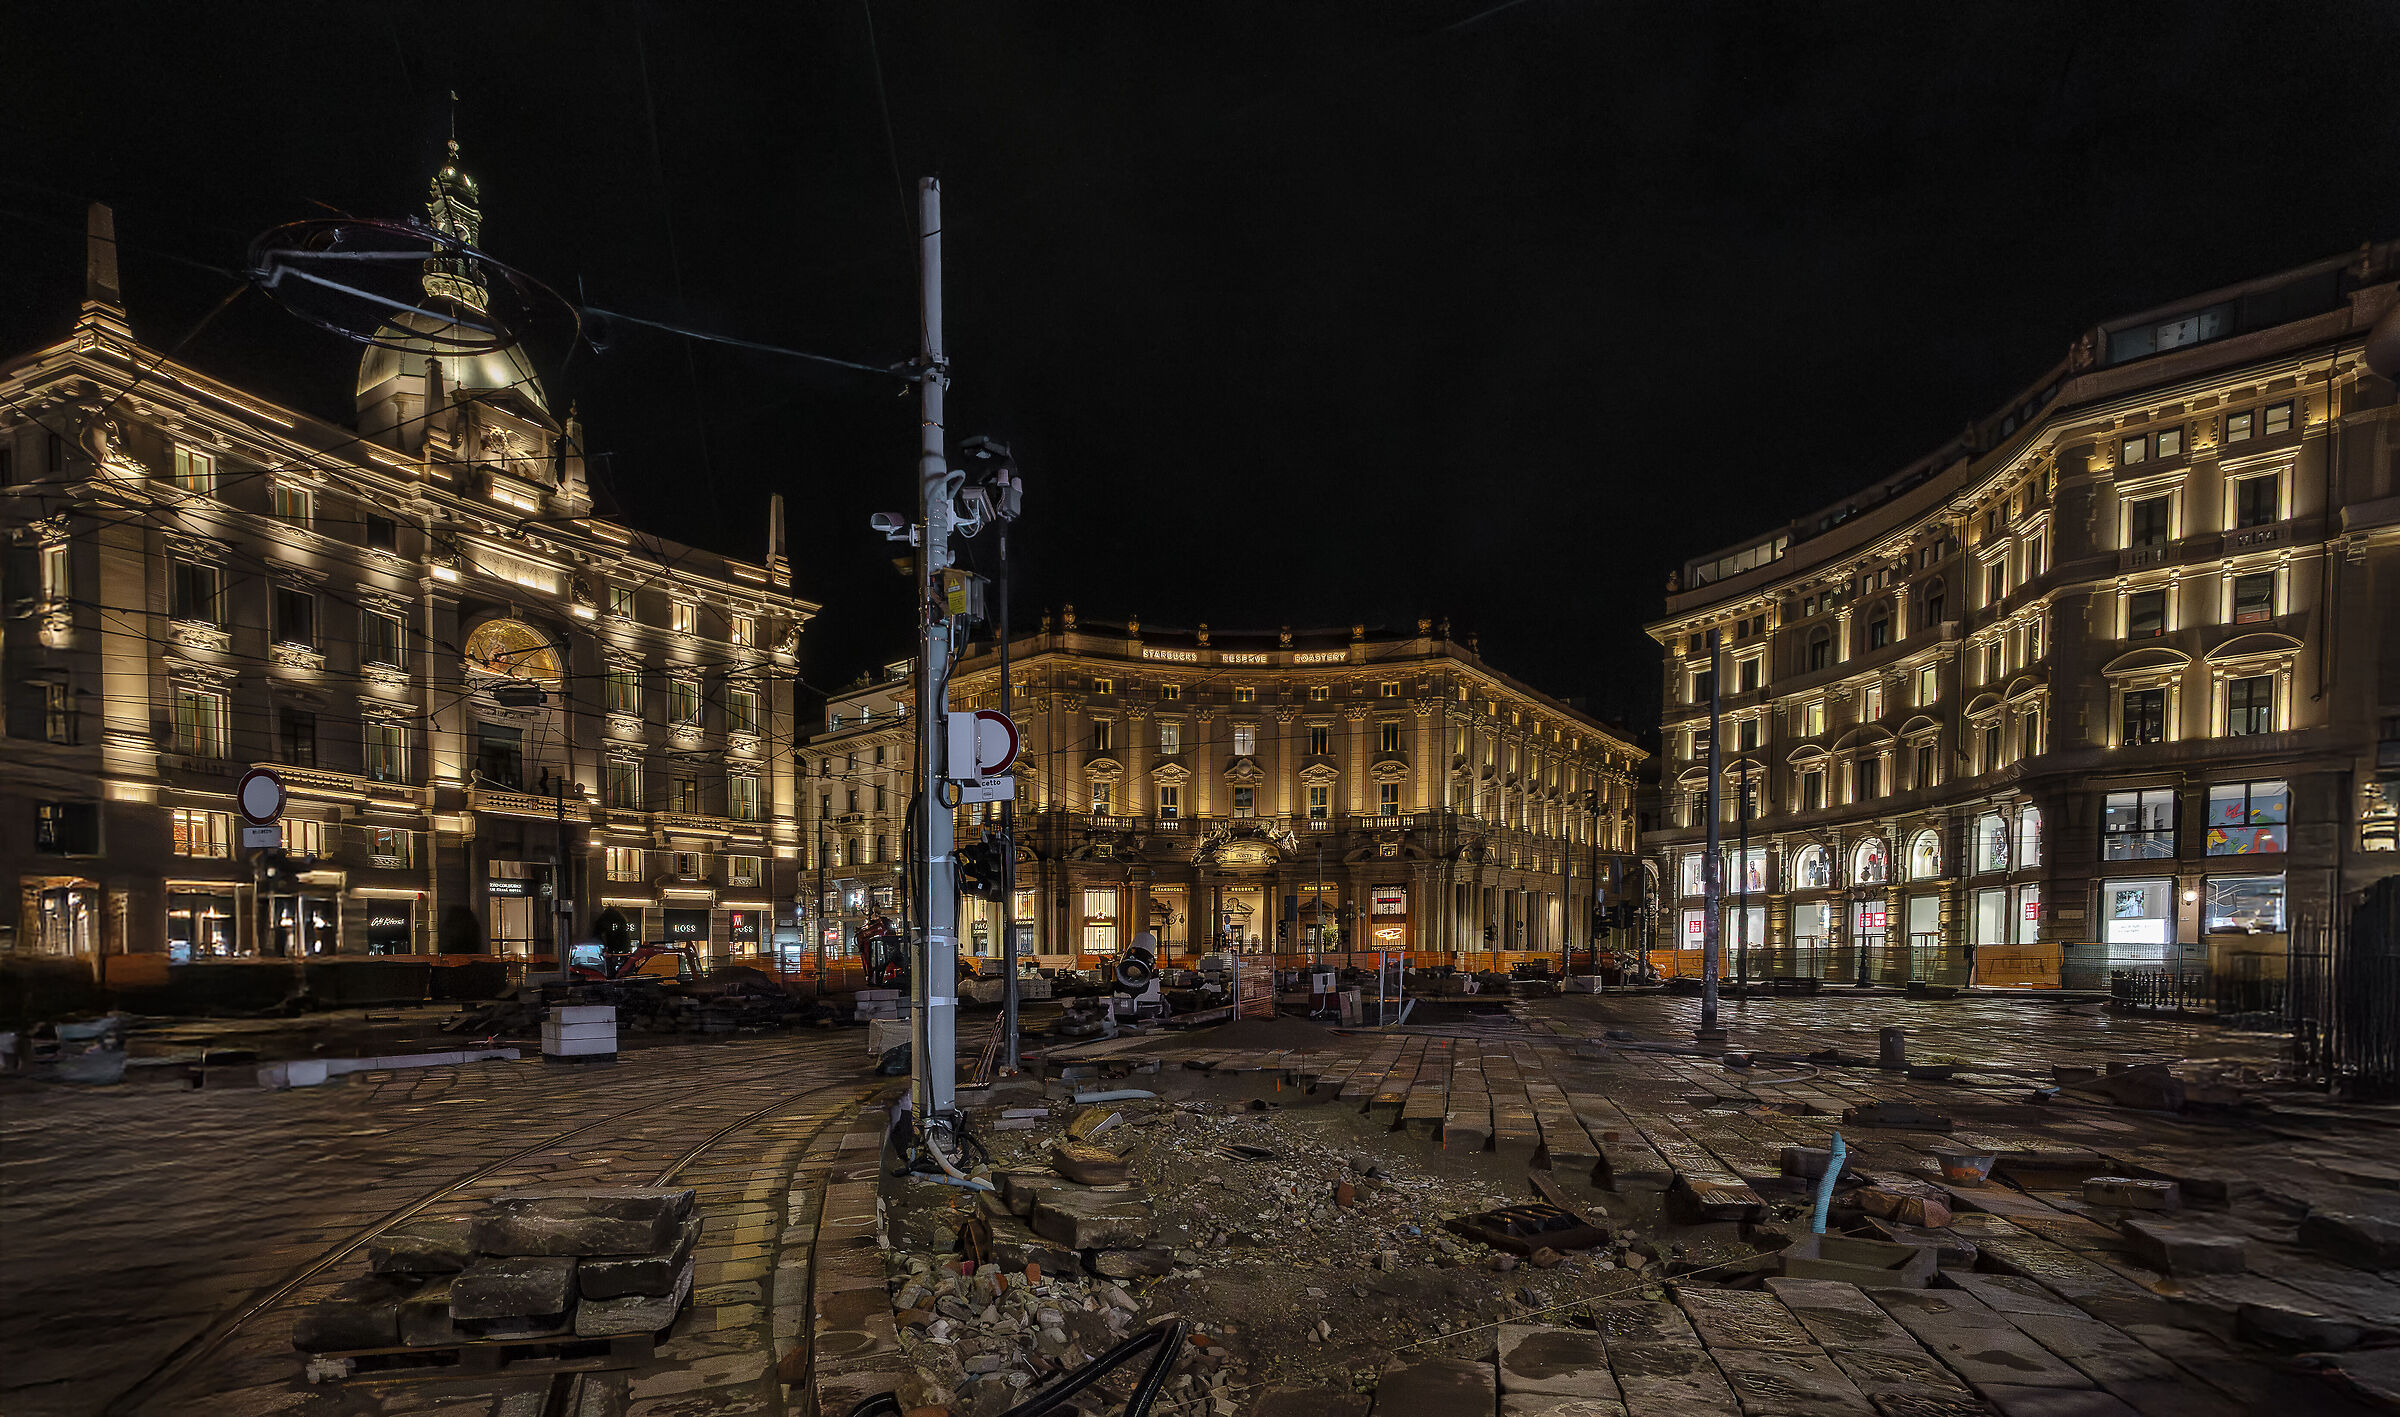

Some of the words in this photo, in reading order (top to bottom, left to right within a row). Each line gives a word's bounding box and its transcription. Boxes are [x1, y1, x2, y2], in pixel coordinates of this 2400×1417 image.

[1143, 649, 1198, 662] STARBUCKS
[1222, 653, 1267, 664] RESERVE
[1294, 653, 1346, 663] ROASTERY
[674, 924, 697, 933] BOSS
